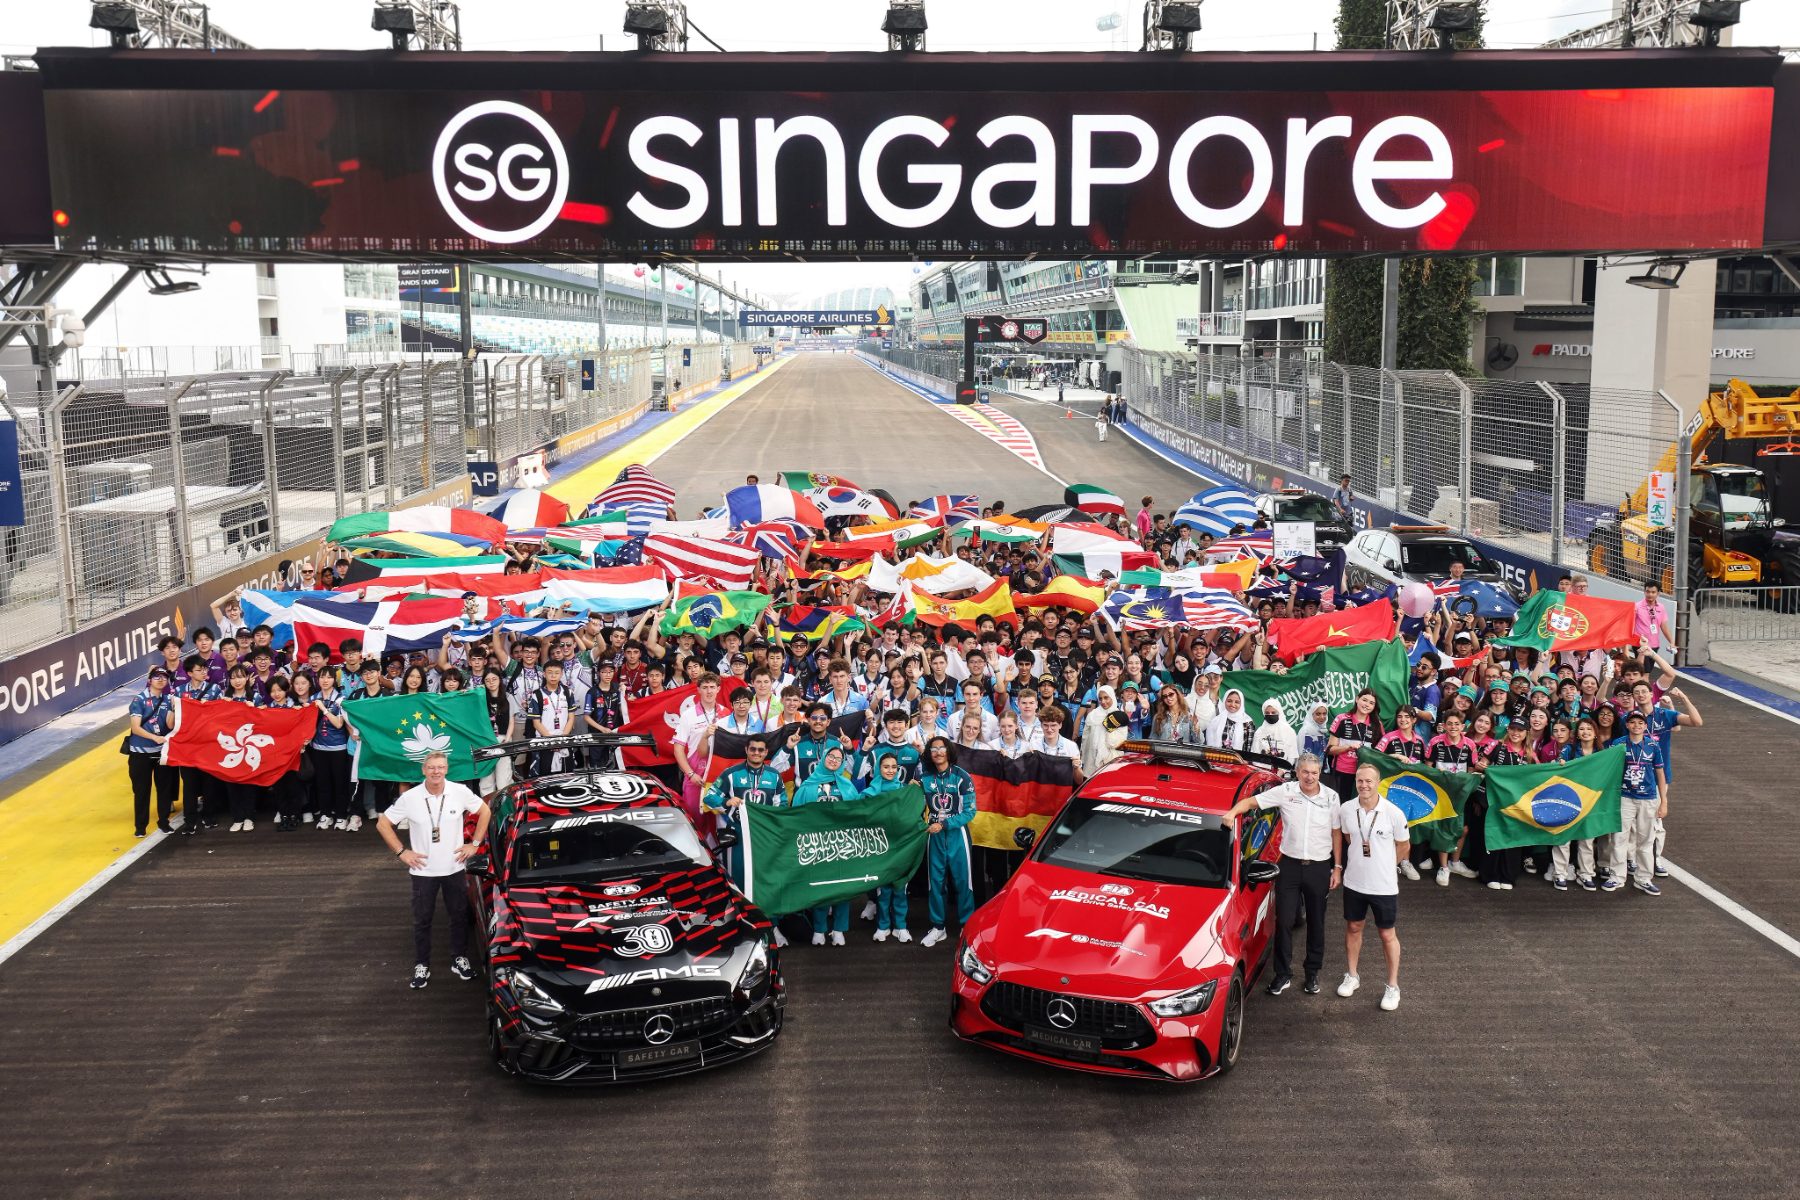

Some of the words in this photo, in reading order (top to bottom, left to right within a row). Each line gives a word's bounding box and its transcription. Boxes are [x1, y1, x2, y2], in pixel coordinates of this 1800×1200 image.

[453, 143, 551, 202] SG
[747, 313, 815, 323] SINGAPORE
[819, 313, 873, 322] AIRLINES
[1552, 344, 1593, 357] PADD
[1682, 411, 1703, 437] CB
[1727, 564, 1752, 572] JCB
[74, 615, 171, 688] AIRLINES
[585, 811, 655, 824] AMG
[1128, 806, 1202, 825] AMG
[588, 898, 638, 910] SAFETY
[1051, 889, 1128, 906] MEDICAL
[1134, 901, 1170, 915] CAR
[611, 923, 674, 957] 30
[628, 964, 721, 985] AMG
[1032, 1030, 1071, 1047] MEDICAL
[1074, 1039, 1092, 1049] CAR
[628, 1049, 668, 1063] SAFETY
[670, 1046, 690, 1056] CAR
